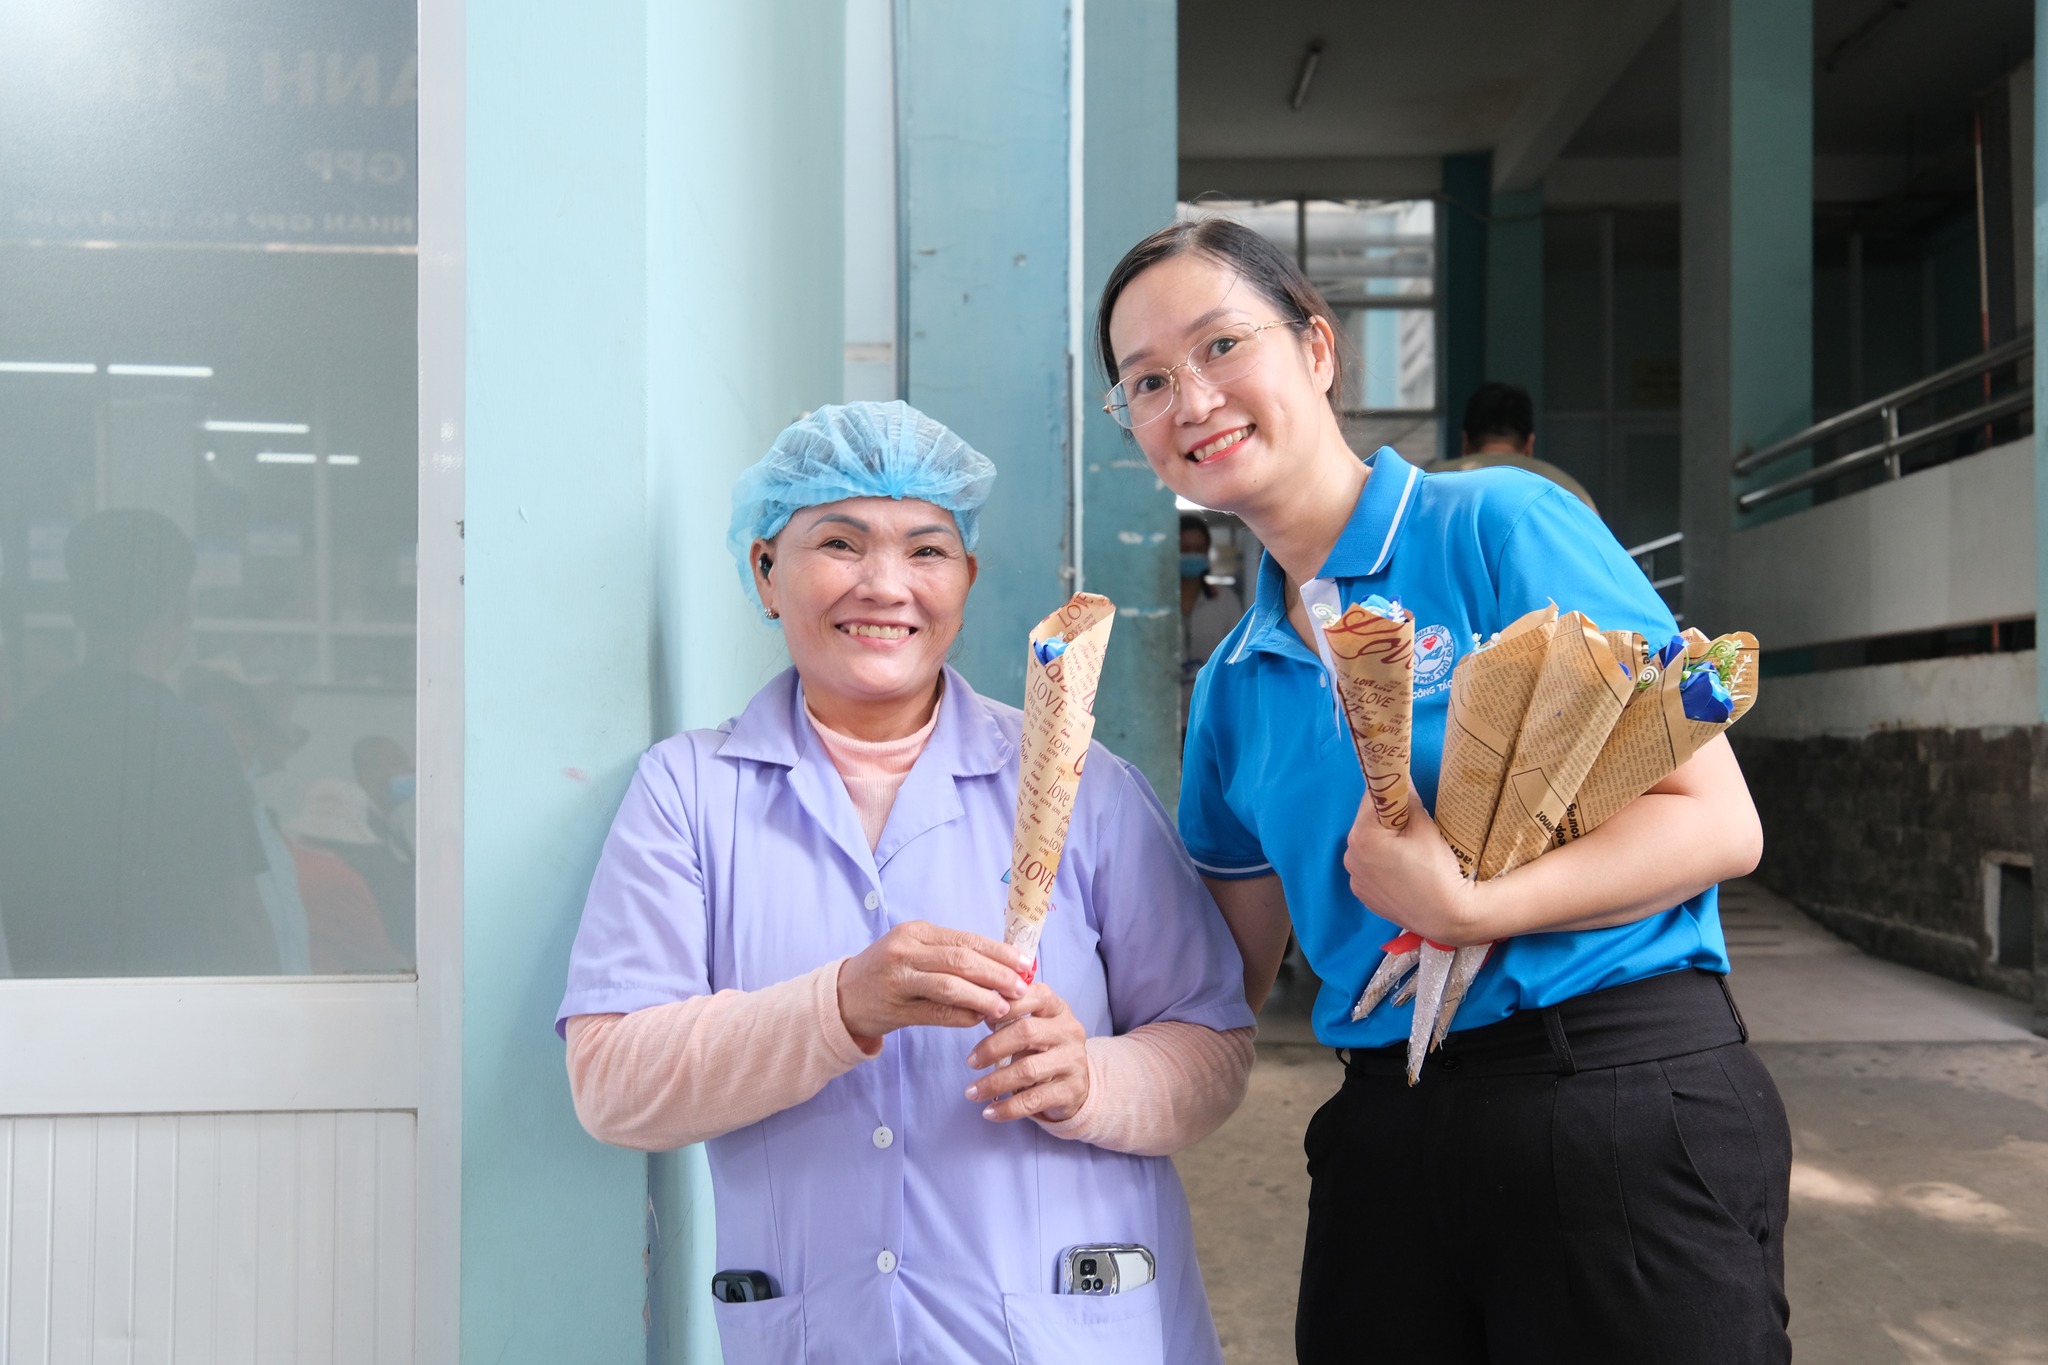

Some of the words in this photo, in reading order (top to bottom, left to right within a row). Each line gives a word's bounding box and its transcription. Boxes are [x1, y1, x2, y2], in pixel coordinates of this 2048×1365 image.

[1324, 610, 1414, 669] Lov
[1354, 677, 1376, 687] LOVE
[1412, 686, 1436, 700] CÔNG
[1437, 678, 1452, 692] TÁC
[1033, 675, 1067, 718] LOVE
[1358, 691, 1395, 708] LOVE
[1377, 723, 1402, 736] LOVE
[1046, 746, 1058, 757] LOVE
[1049, 735, 1071, 756] LOVE
[1364, 741, 1400, 757] LOVE
[1038, 752, 1050, 762] LOVE
[1047, 775, 1070, 807] love
[1040, 796, 1051, 808] LOVE
[1536, 811, 1554, 833] annot
[1567, 803, 1580, 839] courag
[1555, 822, 1566, 846] eop
[1049, 837, 1064, 854] LOV
[1017, 852, 1056, 894] LOVE
[1019, 901, 1030, 912] LOVE
